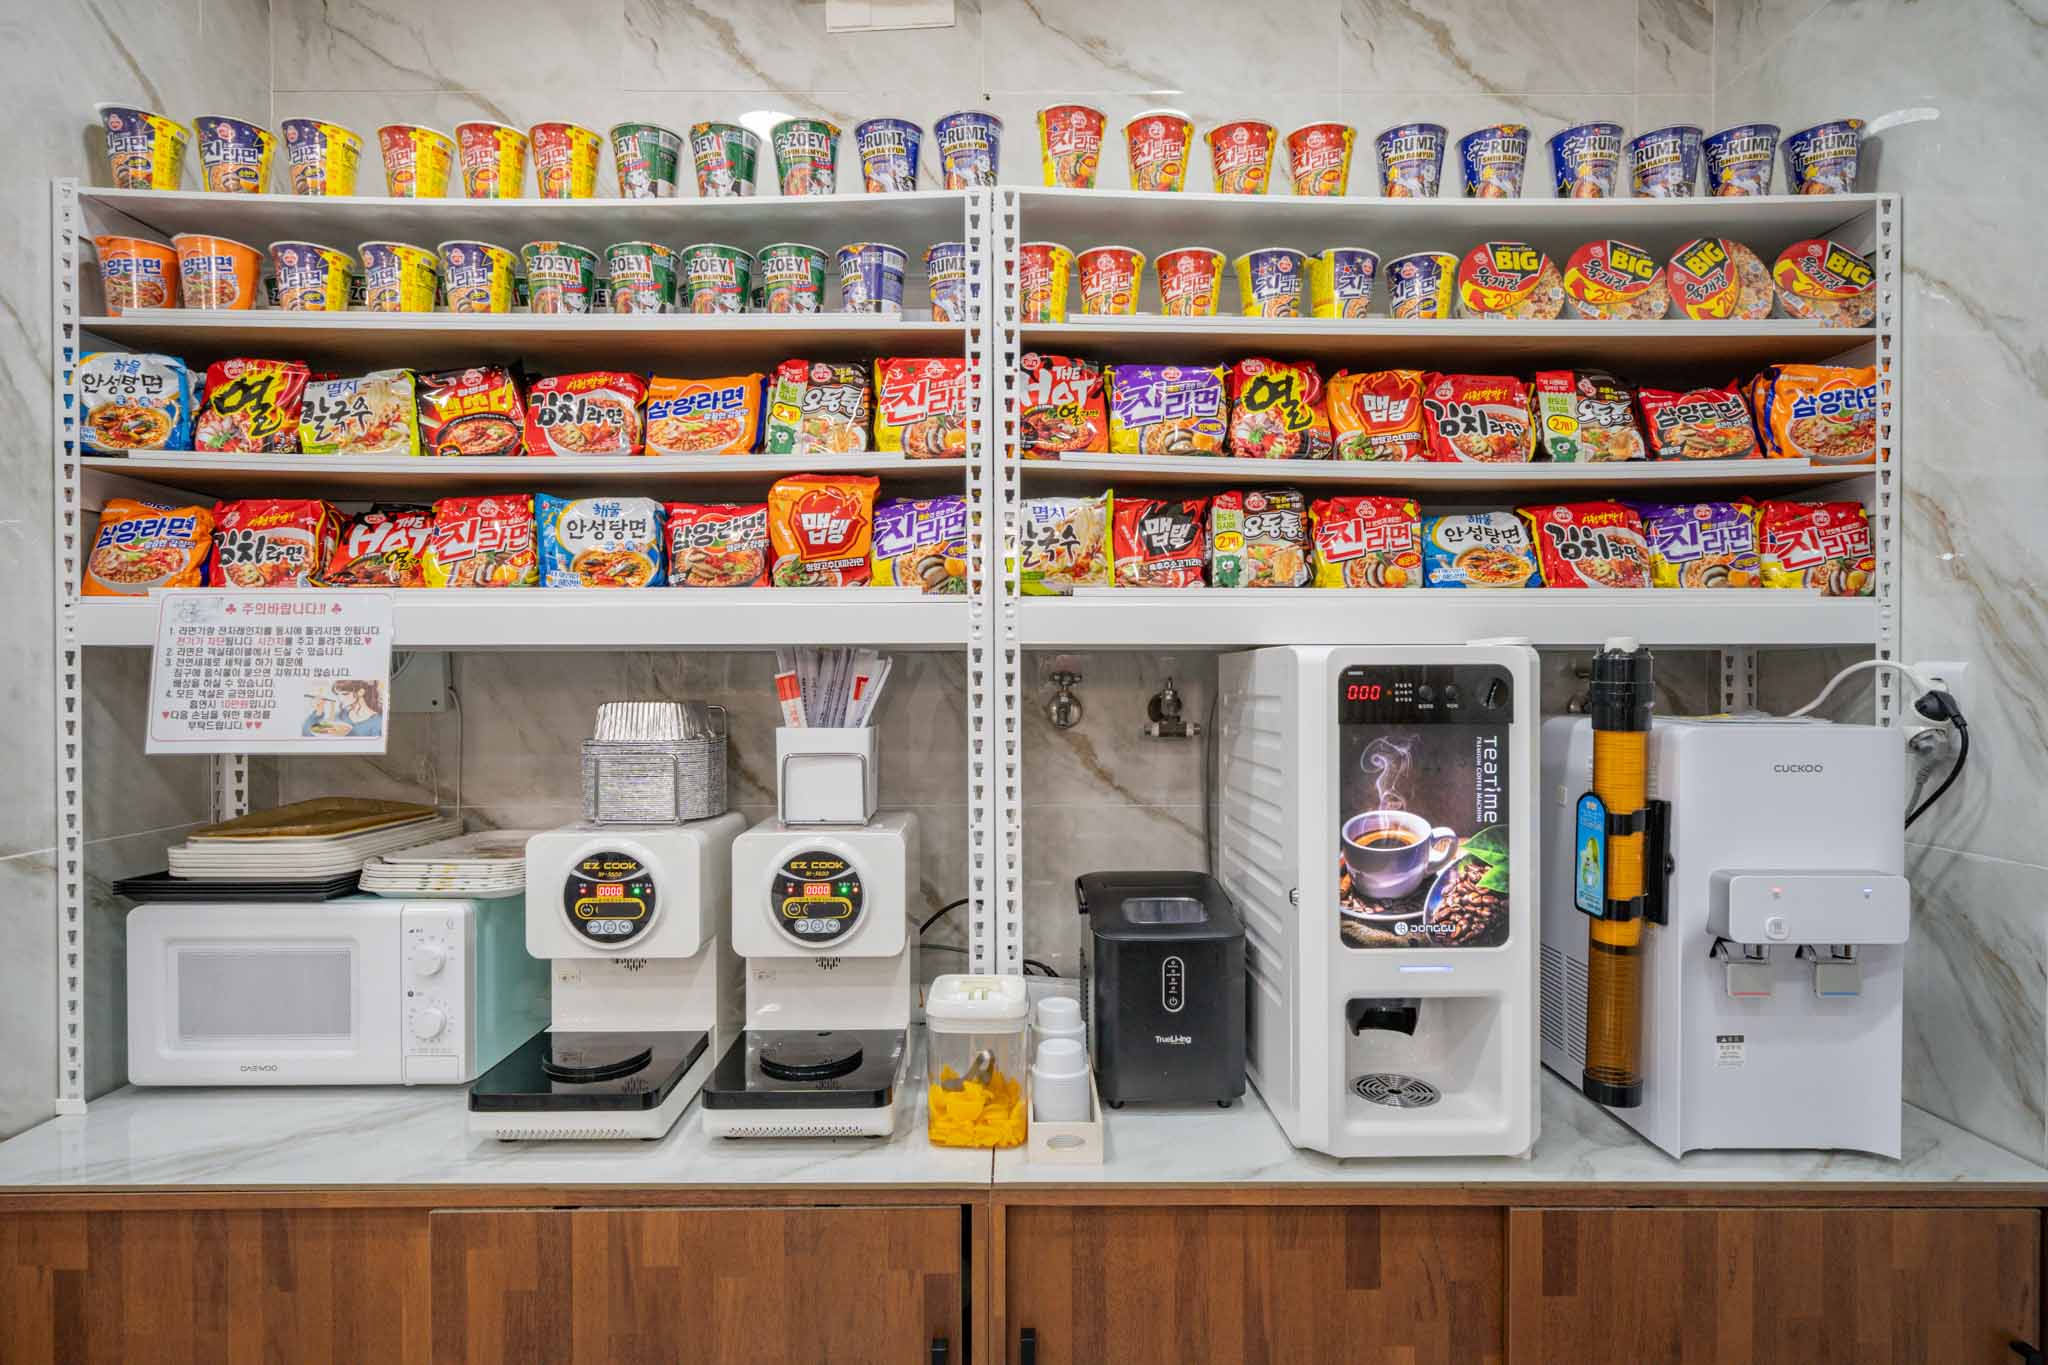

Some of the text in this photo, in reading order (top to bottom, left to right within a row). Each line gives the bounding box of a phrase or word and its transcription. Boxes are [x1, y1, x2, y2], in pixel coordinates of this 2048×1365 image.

[866, 131, 905, 147] RUMI
[948, 127, 987, 144] RUMI
[1393, 136, 1435, 152] RUMI
[1490, 138, 1526, 154] RUMI
[1728, 137, 1772, 154] RUMI
[1812, 134, 1857, 151] RUMI
[202, 140, 258, 168] 진라면
[1635, 140, 1679, 163] RUMI
[536, 256, 573, 271] ZOEY
[612, 256, 643, 271] ZOEY
[693, 258, 727, 273] ZOEY
[768, 258, 803, 273] ZOEY
[1495, 251, 1539, 272] BIG
[1611, 249, 1655, 278] BIG
[1684, 242, 1726, 277] BIG
[1826, 251, 1872, 286] BIG
[1473, 266, 1519, 292] 육개장
[1585, 258, 1627, 291] 육개장
[1800, 256, 1840, 290] 육개장
[1685, 269, 1729, 302] 육개장
[1055, 365, 1081, 381] THE
[81, 374, 163, 396] 안성탕면
[326, 381, 359, 400] 멸치
[212, 376, 286, 438] 열
[530, 391, 624, 427] 김치라면
[649, 384, 745, 421] 삼양라면
[1121, 381, 1221, 430] 진라면
[1243, 376, 1312, 432] 열
[1362, 393, 1409, 422] 맵탱
[1655, 396, 1746, 431] 삼양라면
[1424, 398, 1524, 439] 김치라면
[397, 515, 425, 529] THE
[1032, 504, 1066, 522] 멸치
[96, 515, 197, 550] 삼양라면
[566, 518, 647, 541] 안성탕면
[672, 511, 768, 554] 삼양라면
[801, 511, 848, 546] 맵탱
[1144, 516, 1192, 549] 맵탱
[1317, 517, 1413, 563] 진라면
[1443, 525, 1521, 545] 안성탕면
[431, 516, 534, 567] 진라면
[1545, 523, 1639, 562] 김치라면
[1657, 520, 1753, 564] 진라면
[1770, 526, 1871, 572] 진라면
[177, 647, 204, 657] 라면은
[274, 647, 292, 657] 드실
[295, 648, 304, 657] 수
[255, 658, 273, 668] 하기
[176, 690, 194, 699] 모든
[224, 680, 233, 688] 수
[170, 710, 188, 720] 다음
[1774, 764, 1824, 774] CUCKOO
[583, 861, 637, 870] EZ COOK
[790, 861, 844, 869] EZ COOK
[239, 1064, 280, 1073] DAEWOO
